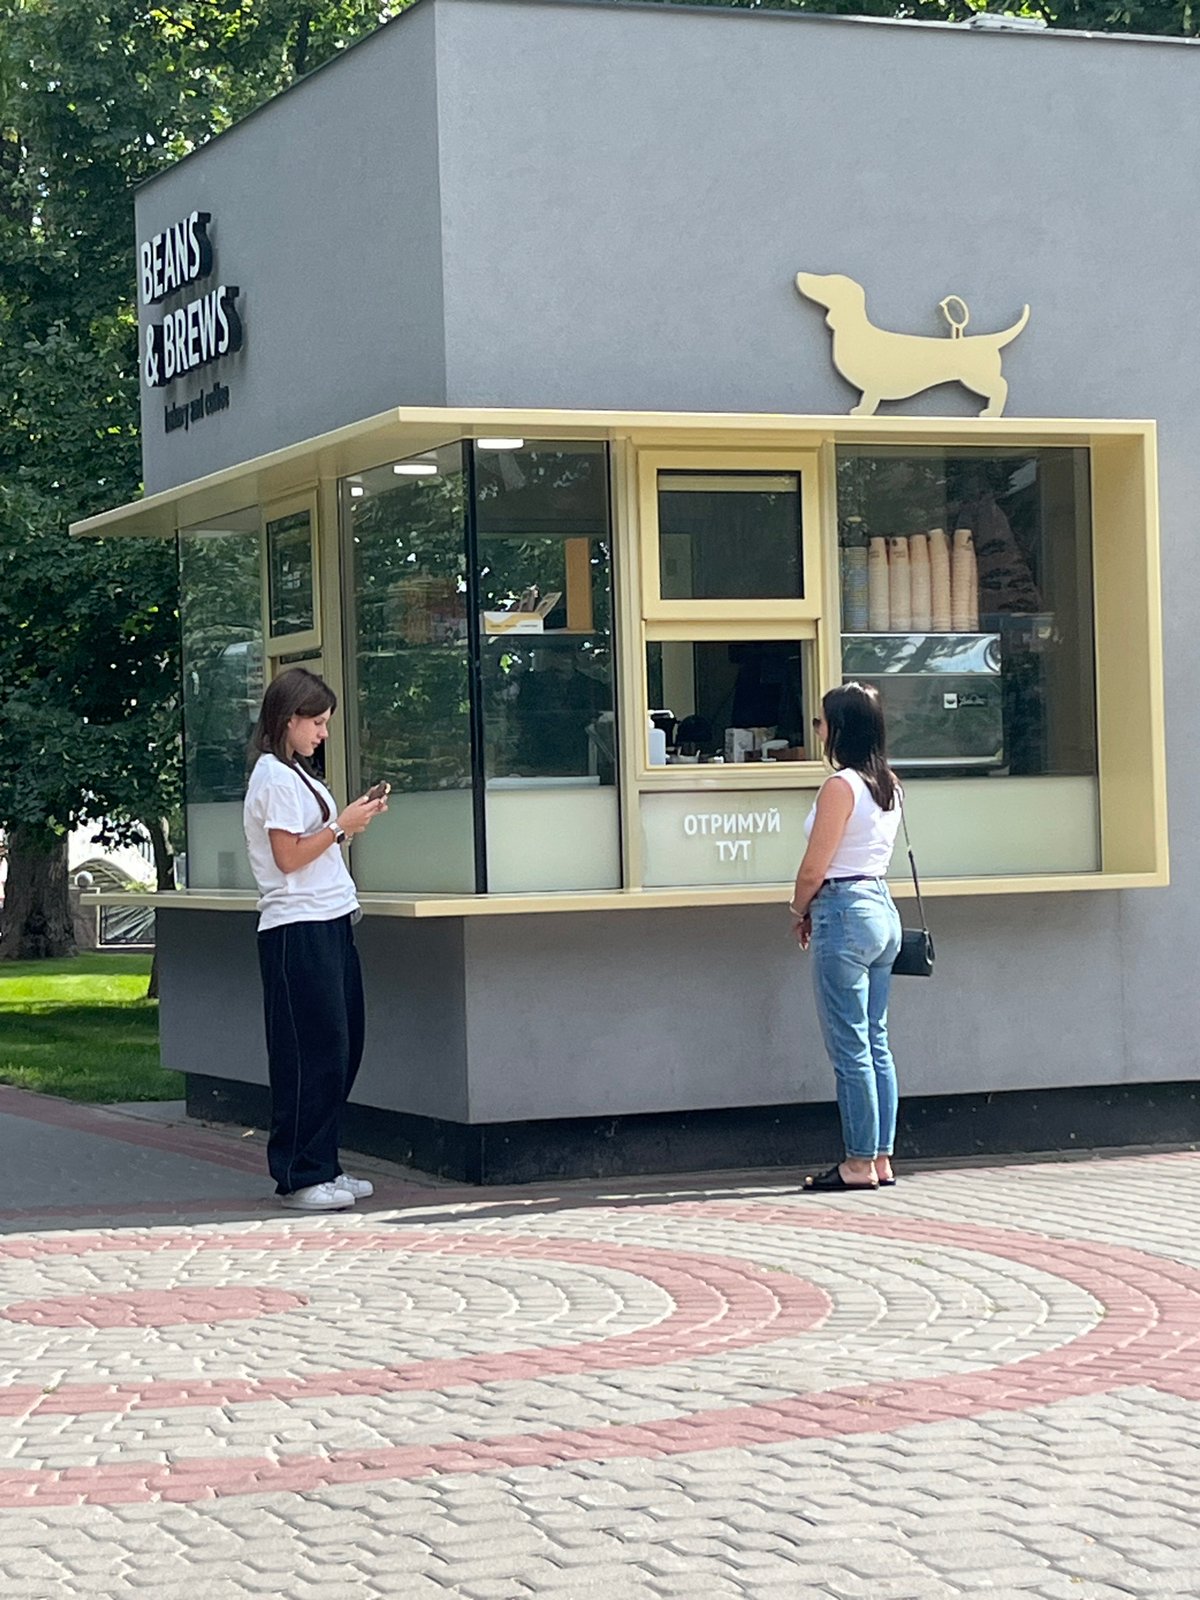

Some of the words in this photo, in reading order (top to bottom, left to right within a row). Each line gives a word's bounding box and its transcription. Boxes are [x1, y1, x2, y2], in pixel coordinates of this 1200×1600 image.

[141, 210, 201, 305] BEANS
[145, 323, 159, 387] &
[163, 285, 230, 379] BREWS
[164, 401, 189, 434] bky
[684, 807, 781, 835] ОТРИМУЙ
[716, 840, 751, 861] ТУТ
